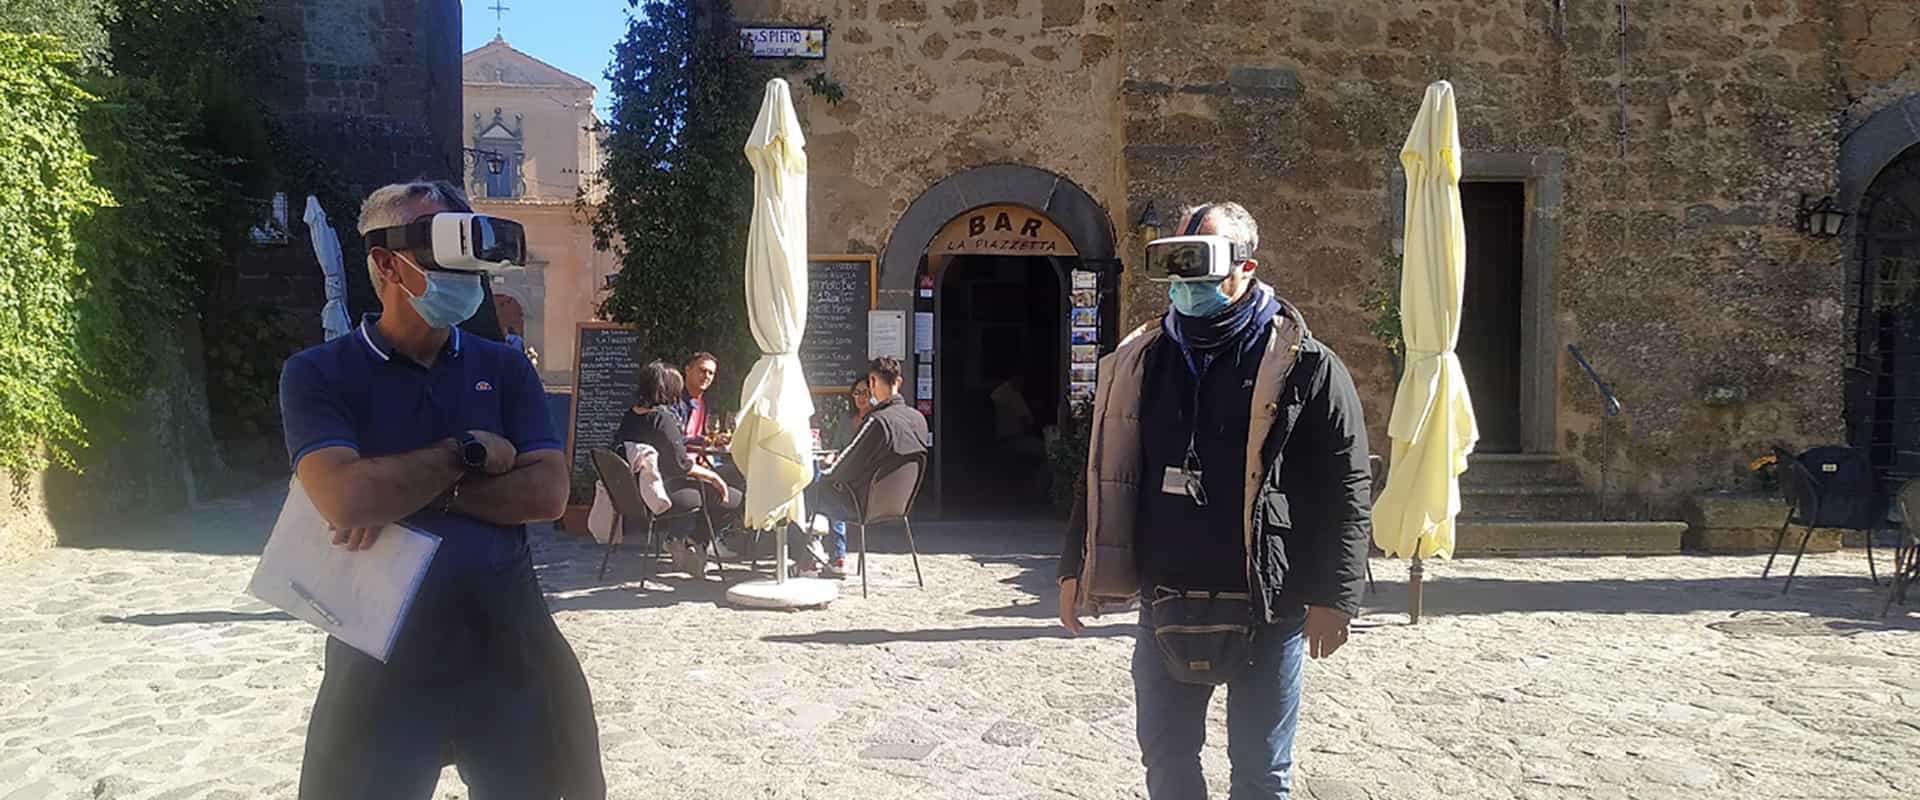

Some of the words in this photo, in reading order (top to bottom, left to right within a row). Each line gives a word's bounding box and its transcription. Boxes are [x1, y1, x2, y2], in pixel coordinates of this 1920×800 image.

[969, 212, 1042, 238] BAR
[948, 240, 966, 251] LA
[975, 240, 1056, 251] PIAZZETTA
